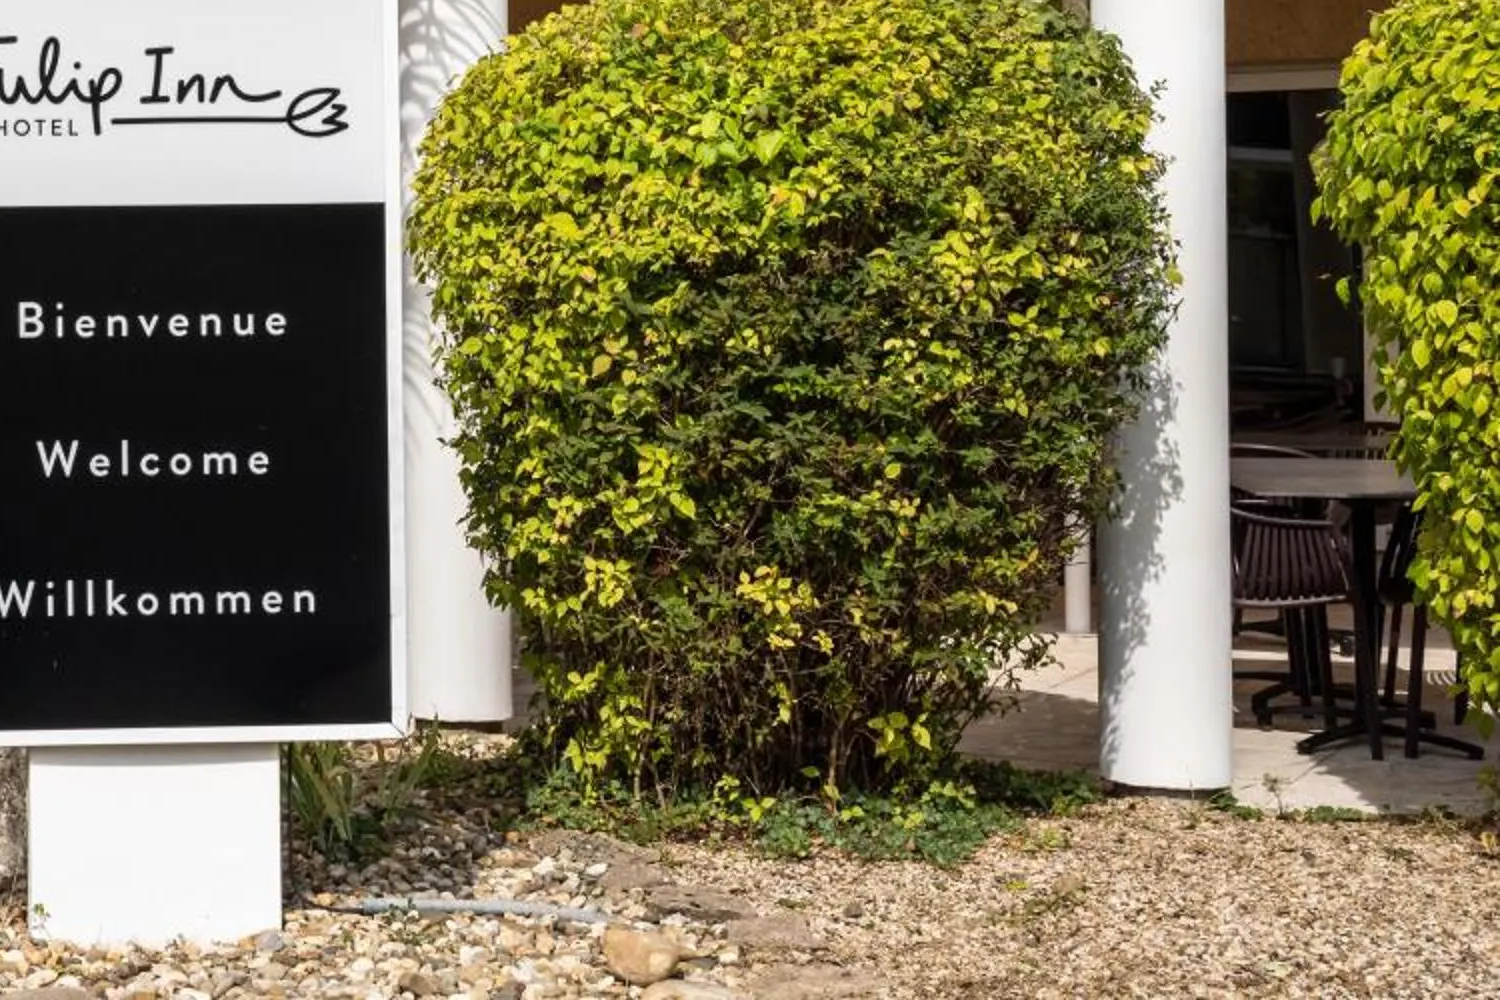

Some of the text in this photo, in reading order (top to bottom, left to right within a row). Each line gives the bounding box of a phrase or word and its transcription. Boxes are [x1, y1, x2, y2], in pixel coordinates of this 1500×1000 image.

[139, 46, 282, 105] Inn
[17, 301, 288, 339] Bienvenue
[35, 439, 270, 478] Welcome
